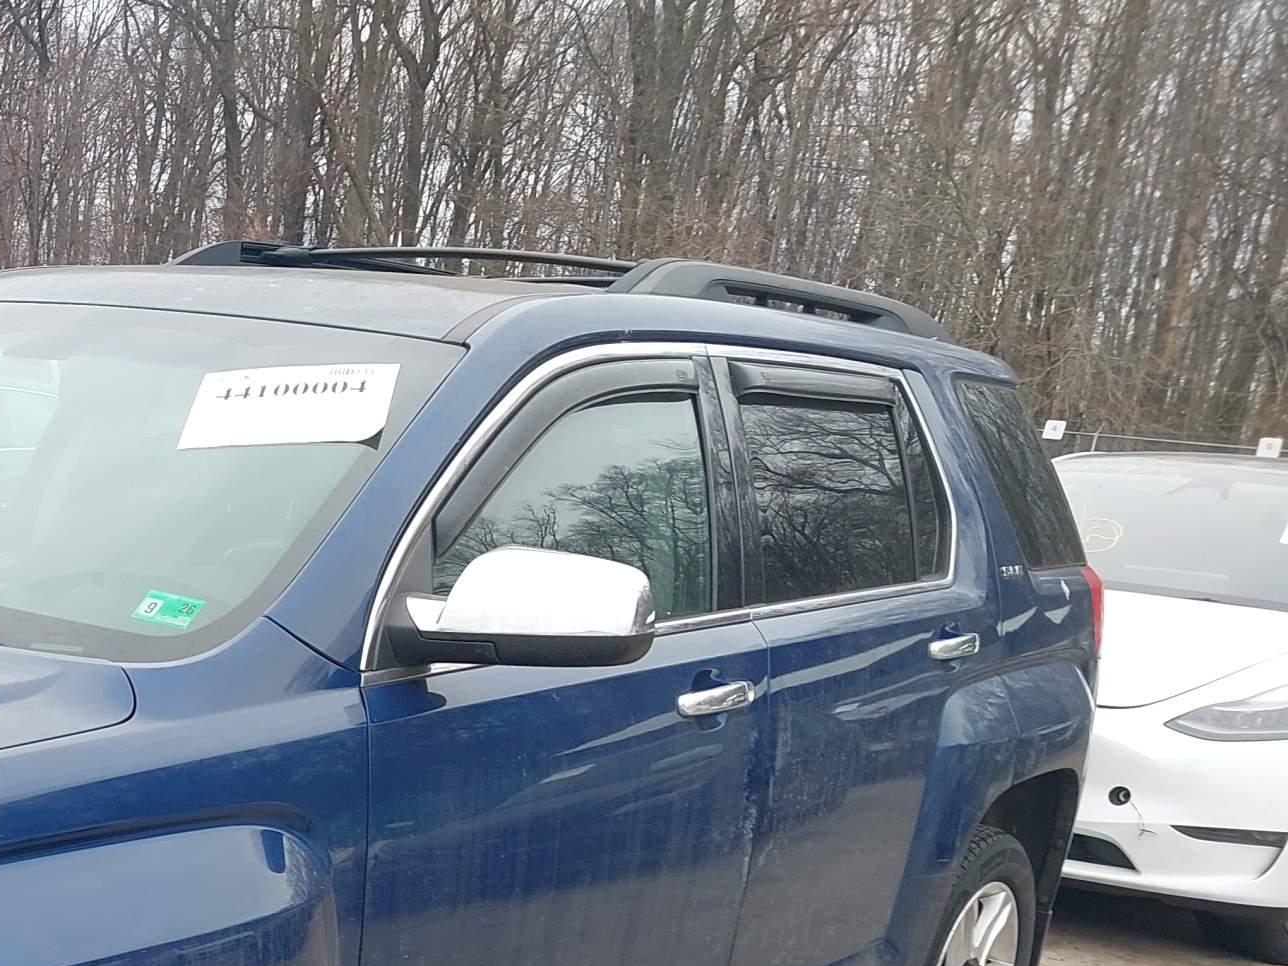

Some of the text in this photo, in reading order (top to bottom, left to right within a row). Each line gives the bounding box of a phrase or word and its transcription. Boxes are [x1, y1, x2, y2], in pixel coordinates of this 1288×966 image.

[216, 380, 366, 400] 44100004
[144, 602, 197, 615] 9 26
